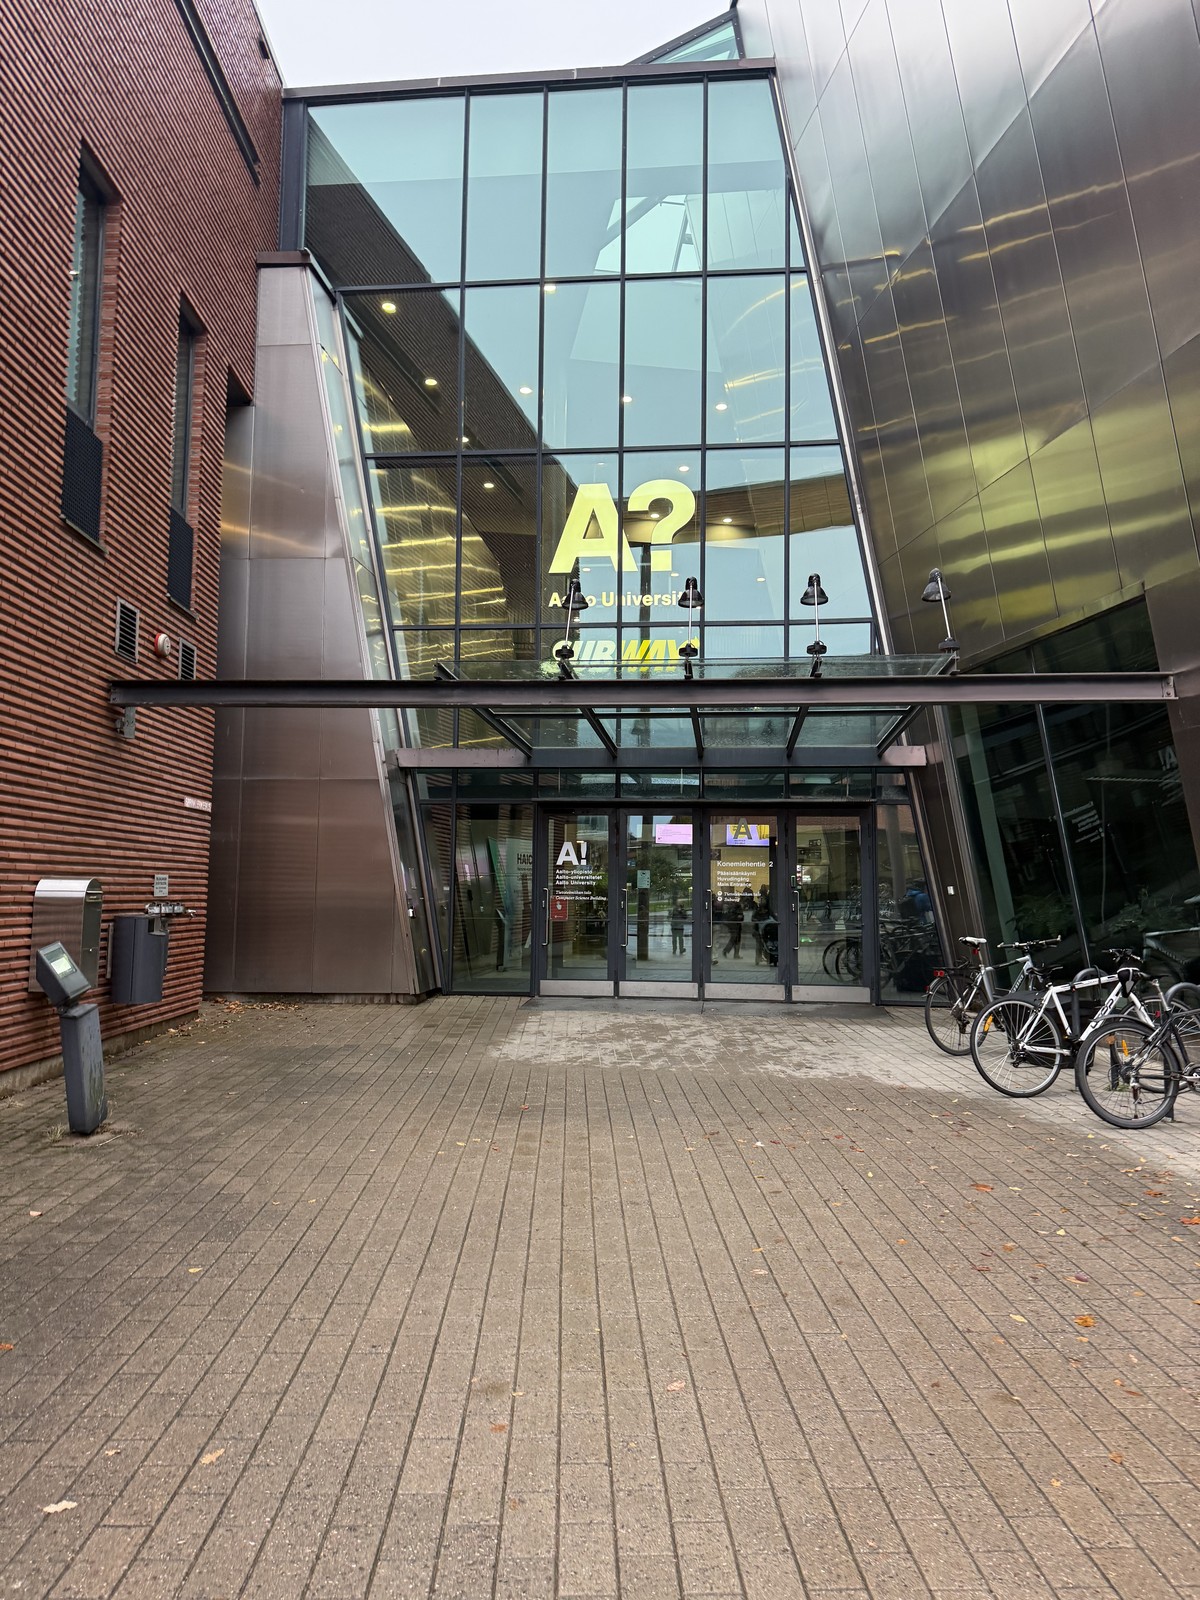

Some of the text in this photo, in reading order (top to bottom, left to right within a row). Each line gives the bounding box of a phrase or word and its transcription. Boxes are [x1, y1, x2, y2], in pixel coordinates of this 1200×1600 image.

[549, 479, 696, 574] A?
[602, 590, 684, 607] Universi
[556, 841, 587, 866] A!
